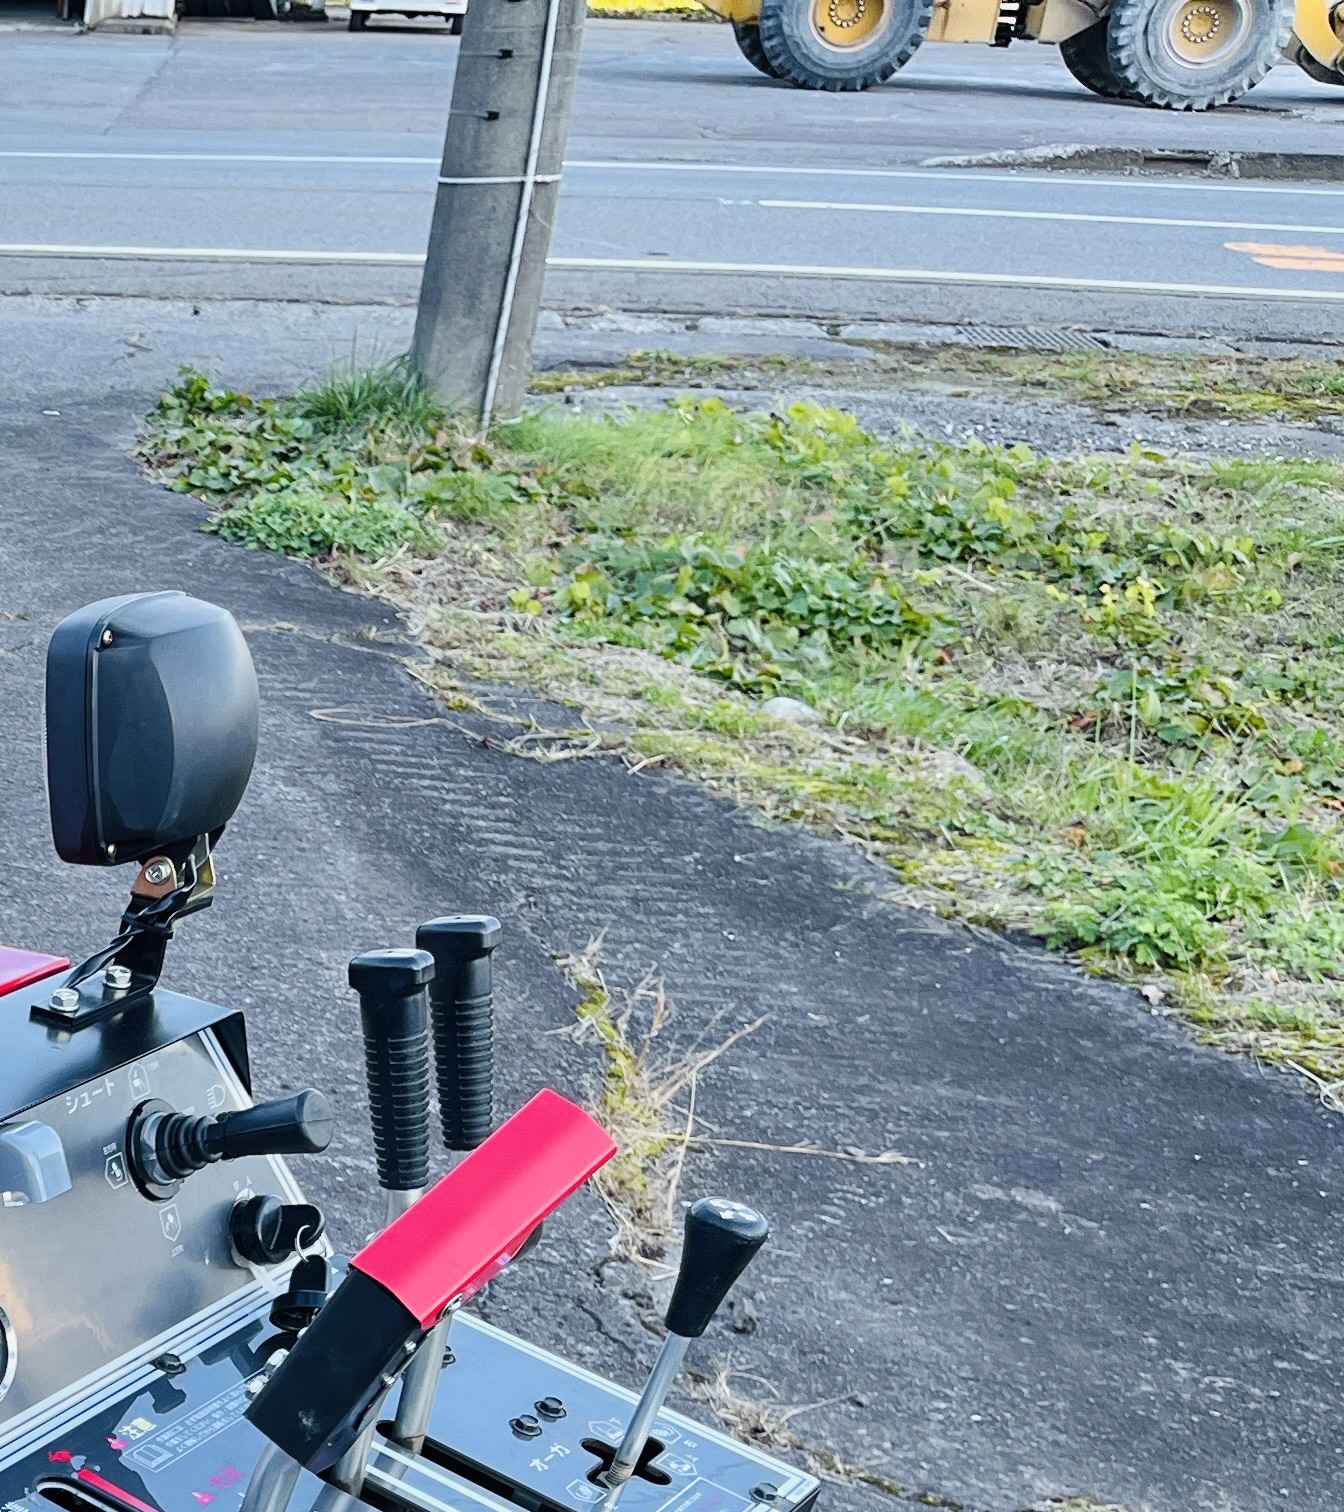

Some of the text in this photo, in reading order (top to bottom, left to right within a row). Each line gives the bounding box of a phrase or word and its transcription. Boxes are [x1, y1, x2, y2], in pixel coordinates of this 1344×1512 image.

[65, 1077, 115, 1115] シュート
[528, 1442, 570, 1473] オーガ
